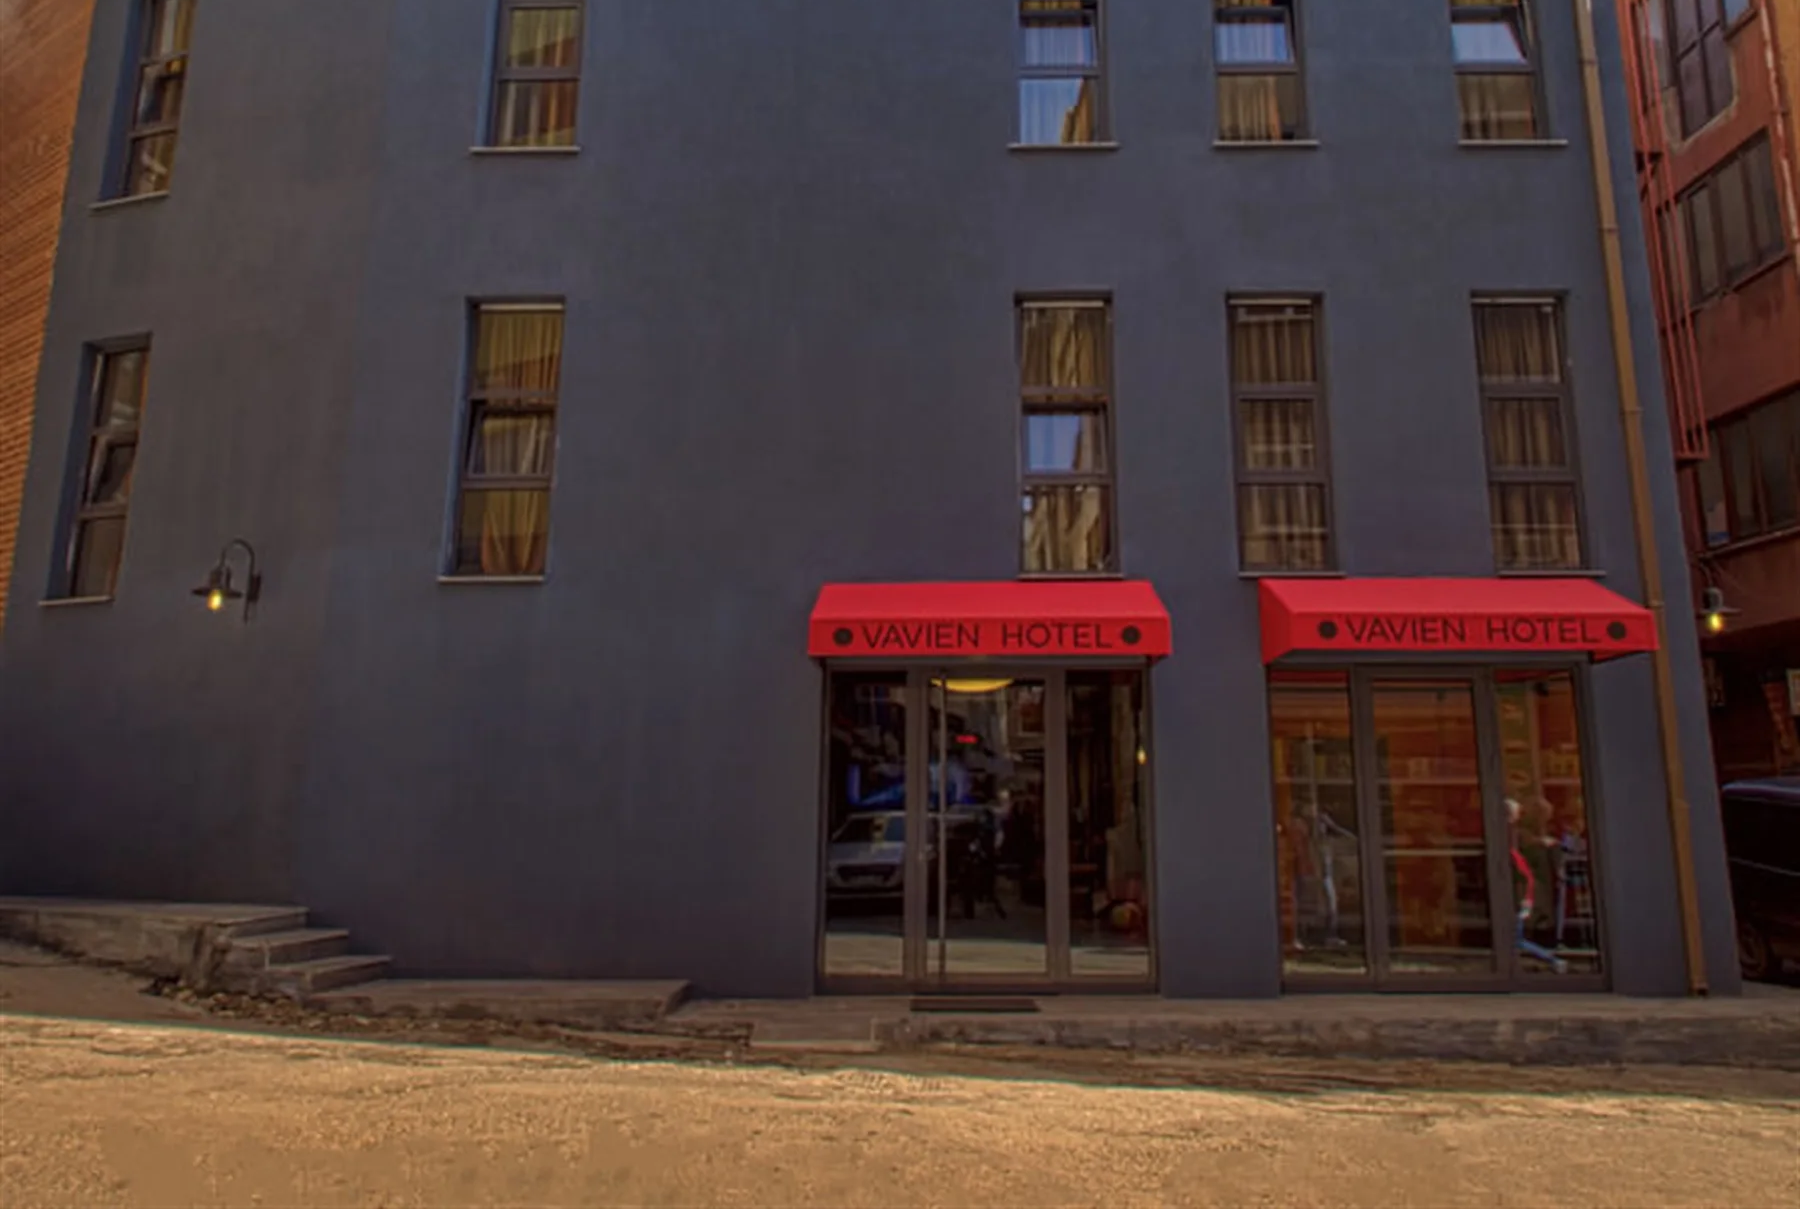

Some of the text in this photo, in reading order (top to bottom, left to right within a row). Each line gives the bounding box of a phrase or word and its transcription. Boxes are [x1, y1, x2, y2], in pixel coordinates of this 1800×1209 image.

[860, 621, 1113, 649] VAVIEN HOTEL
[1344, 616, 1600, 644] VAVIEN HOTEL
